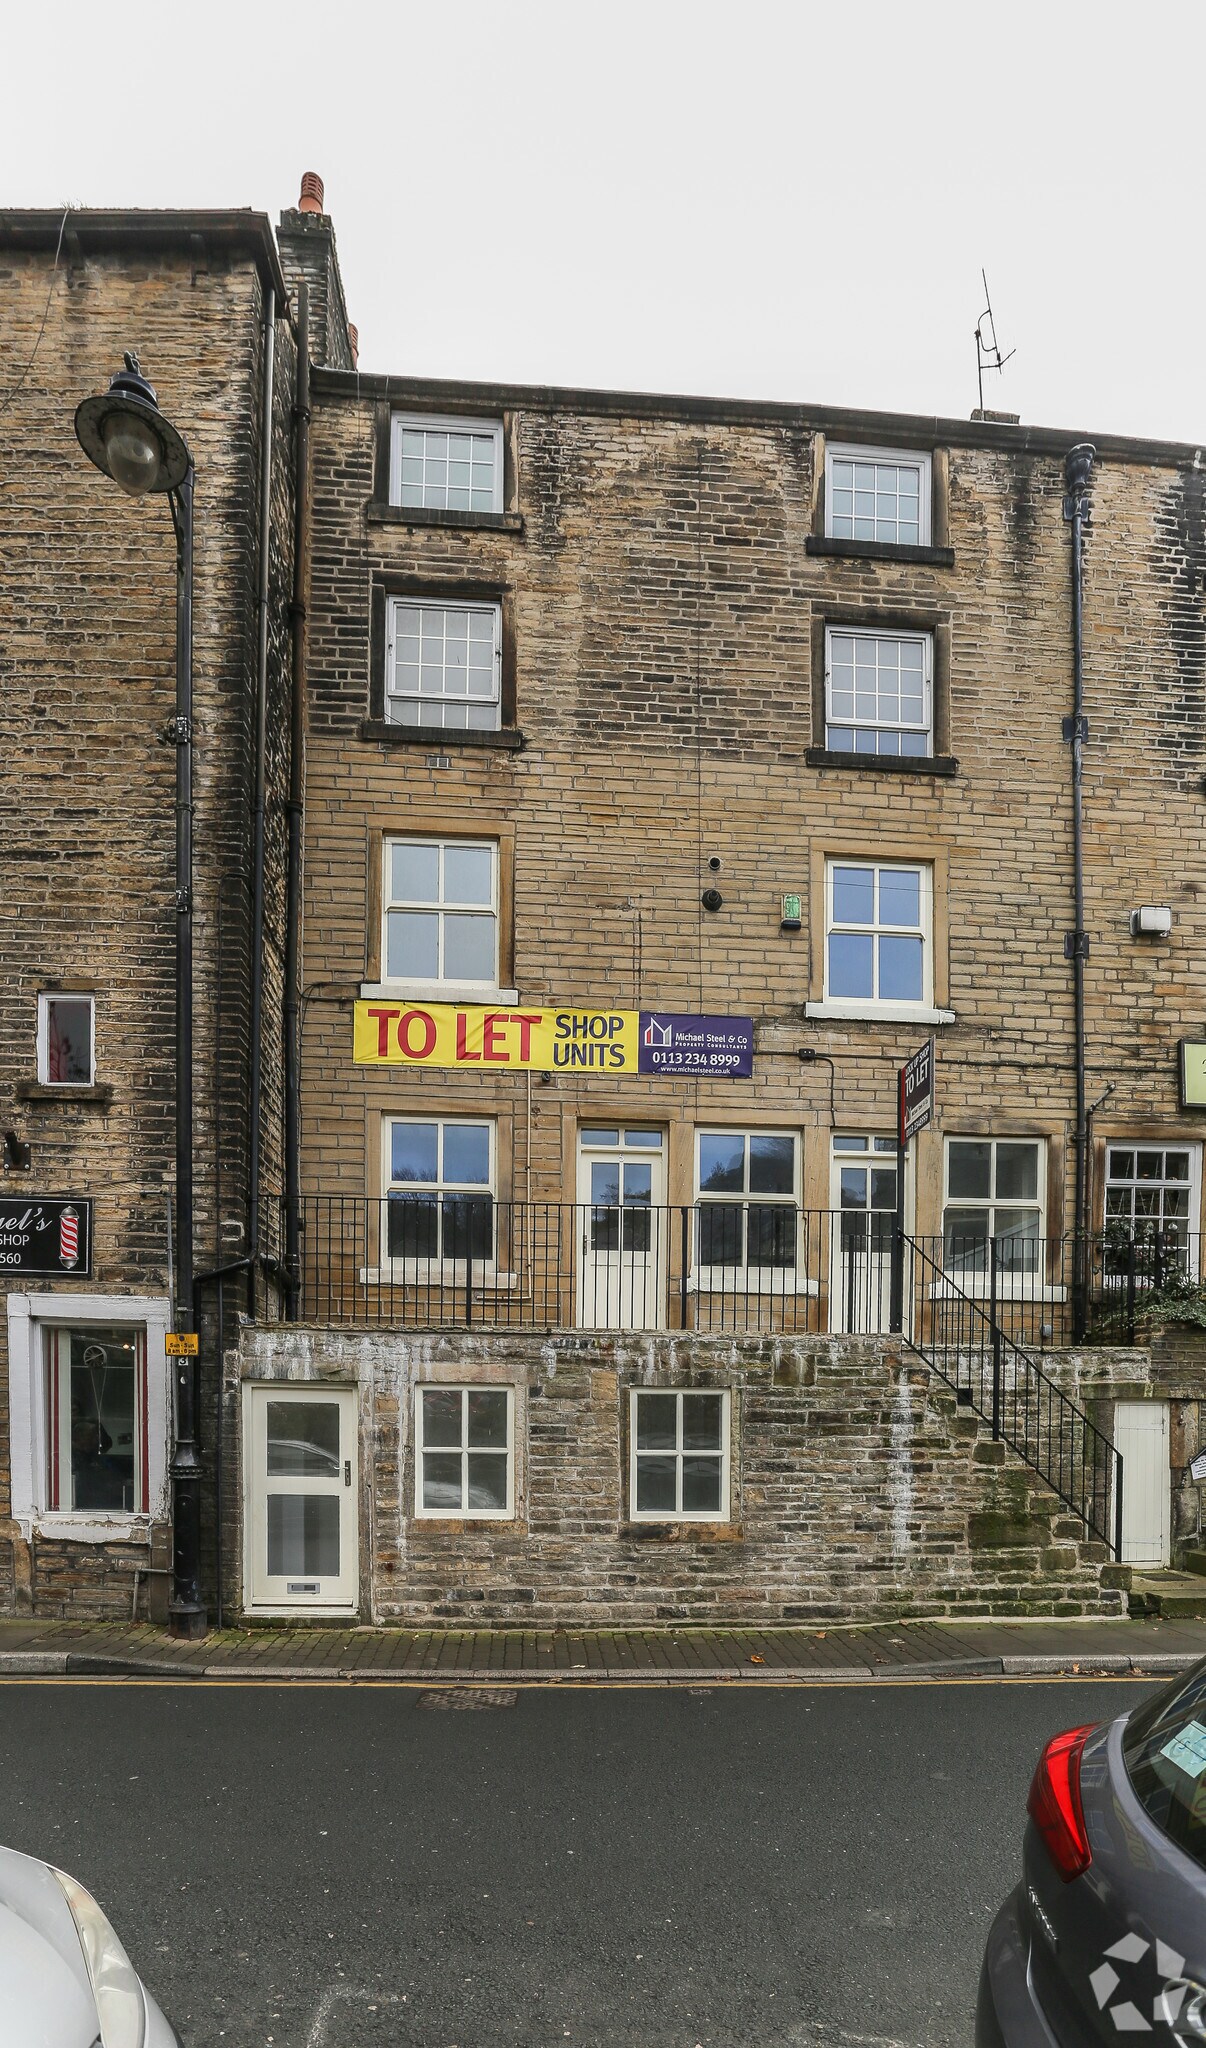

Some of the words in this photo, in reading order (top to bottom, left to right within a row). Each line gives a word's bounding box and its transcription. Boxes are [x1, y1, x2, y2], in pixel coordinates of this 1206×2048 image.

[368, 1009, 436, 1059] TO
[457, 1013, 542, 1061] LET
[555, 1014, 624, 1039] SHOP
[675, 1033, 704, 1042] Michael
[706, 1034, 726, 1043] Steel
[728, 1035, 736, 1043] &
[737, 1036, 748, 1044] Co
[553, 1043, 625, 1067] UNITS
[652, 1051, 683, 1065] 0113
[685, 1053, 707, 1065] 234
[710, 1054, 740, 1066] 8999
[660, 1066, 730, 1074] www.michaelsteel.co.uk
[905, 1073, 914, 1097] TO
[916, 1057, 929, 1087] LET
